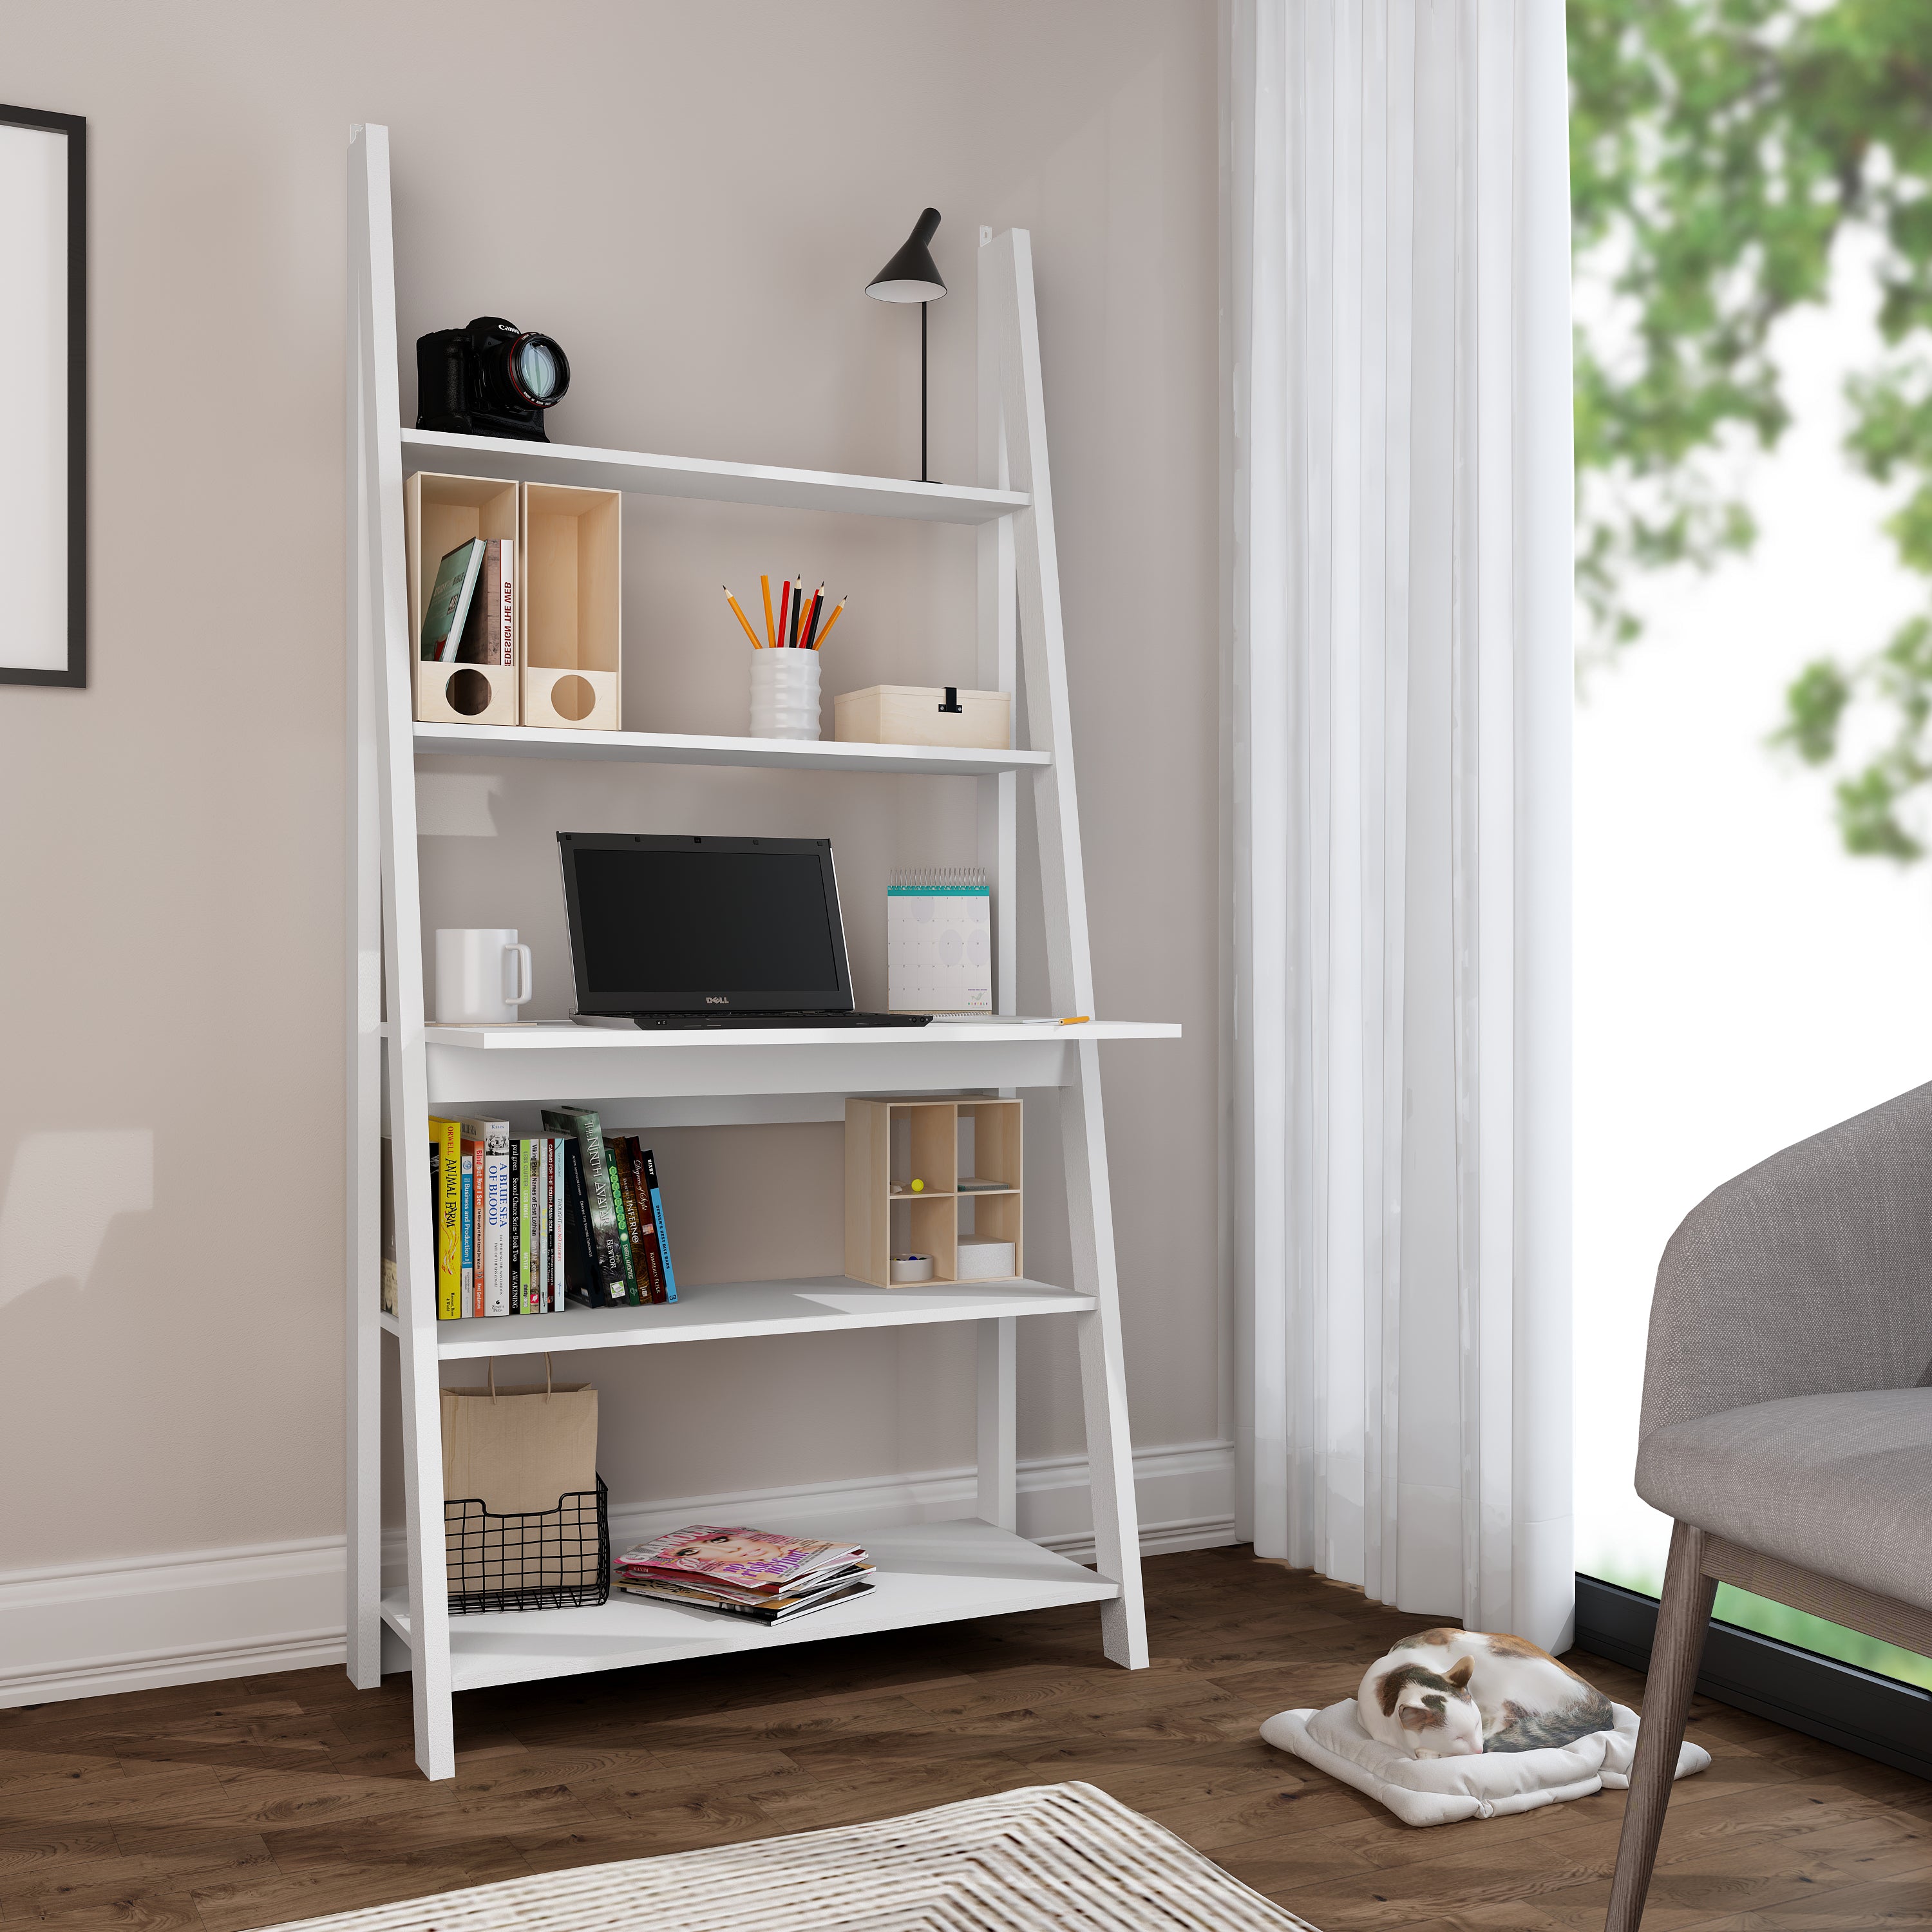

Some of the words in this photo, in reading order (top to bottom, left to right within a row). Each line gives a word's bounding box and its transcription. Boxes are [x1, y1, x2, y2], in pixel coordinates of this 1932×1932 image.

[498, 324, 519, 334] Canon
[584, 1119, 594, 1137] THE
[499, 1163, 507, 1171] A
[587, 1136, 603, 1178] NINTH
[445, 1158, 457, 1198] ANIMAL
[489, 1166, 497, 1181] OF
[632, 1160, 643, 1185] Degrees
[638, 1192, 648, 1211] Sight
[445, 1201, 457, 1228] FARM
[489, 1184, 497, 1226] BLOOD
[594, 1182, 610, 1227] AVATAR
[626, 1200, 639, 1243] INFERNO
[606, 1239, 616, 1270] NEWTON
[620, 1525, 720, 1563] GLAMOUR
[772, 1549, 809, 1568] fun!
[723, 1563, 746, 1573] no
[764, 1564, 788, 1574] no
